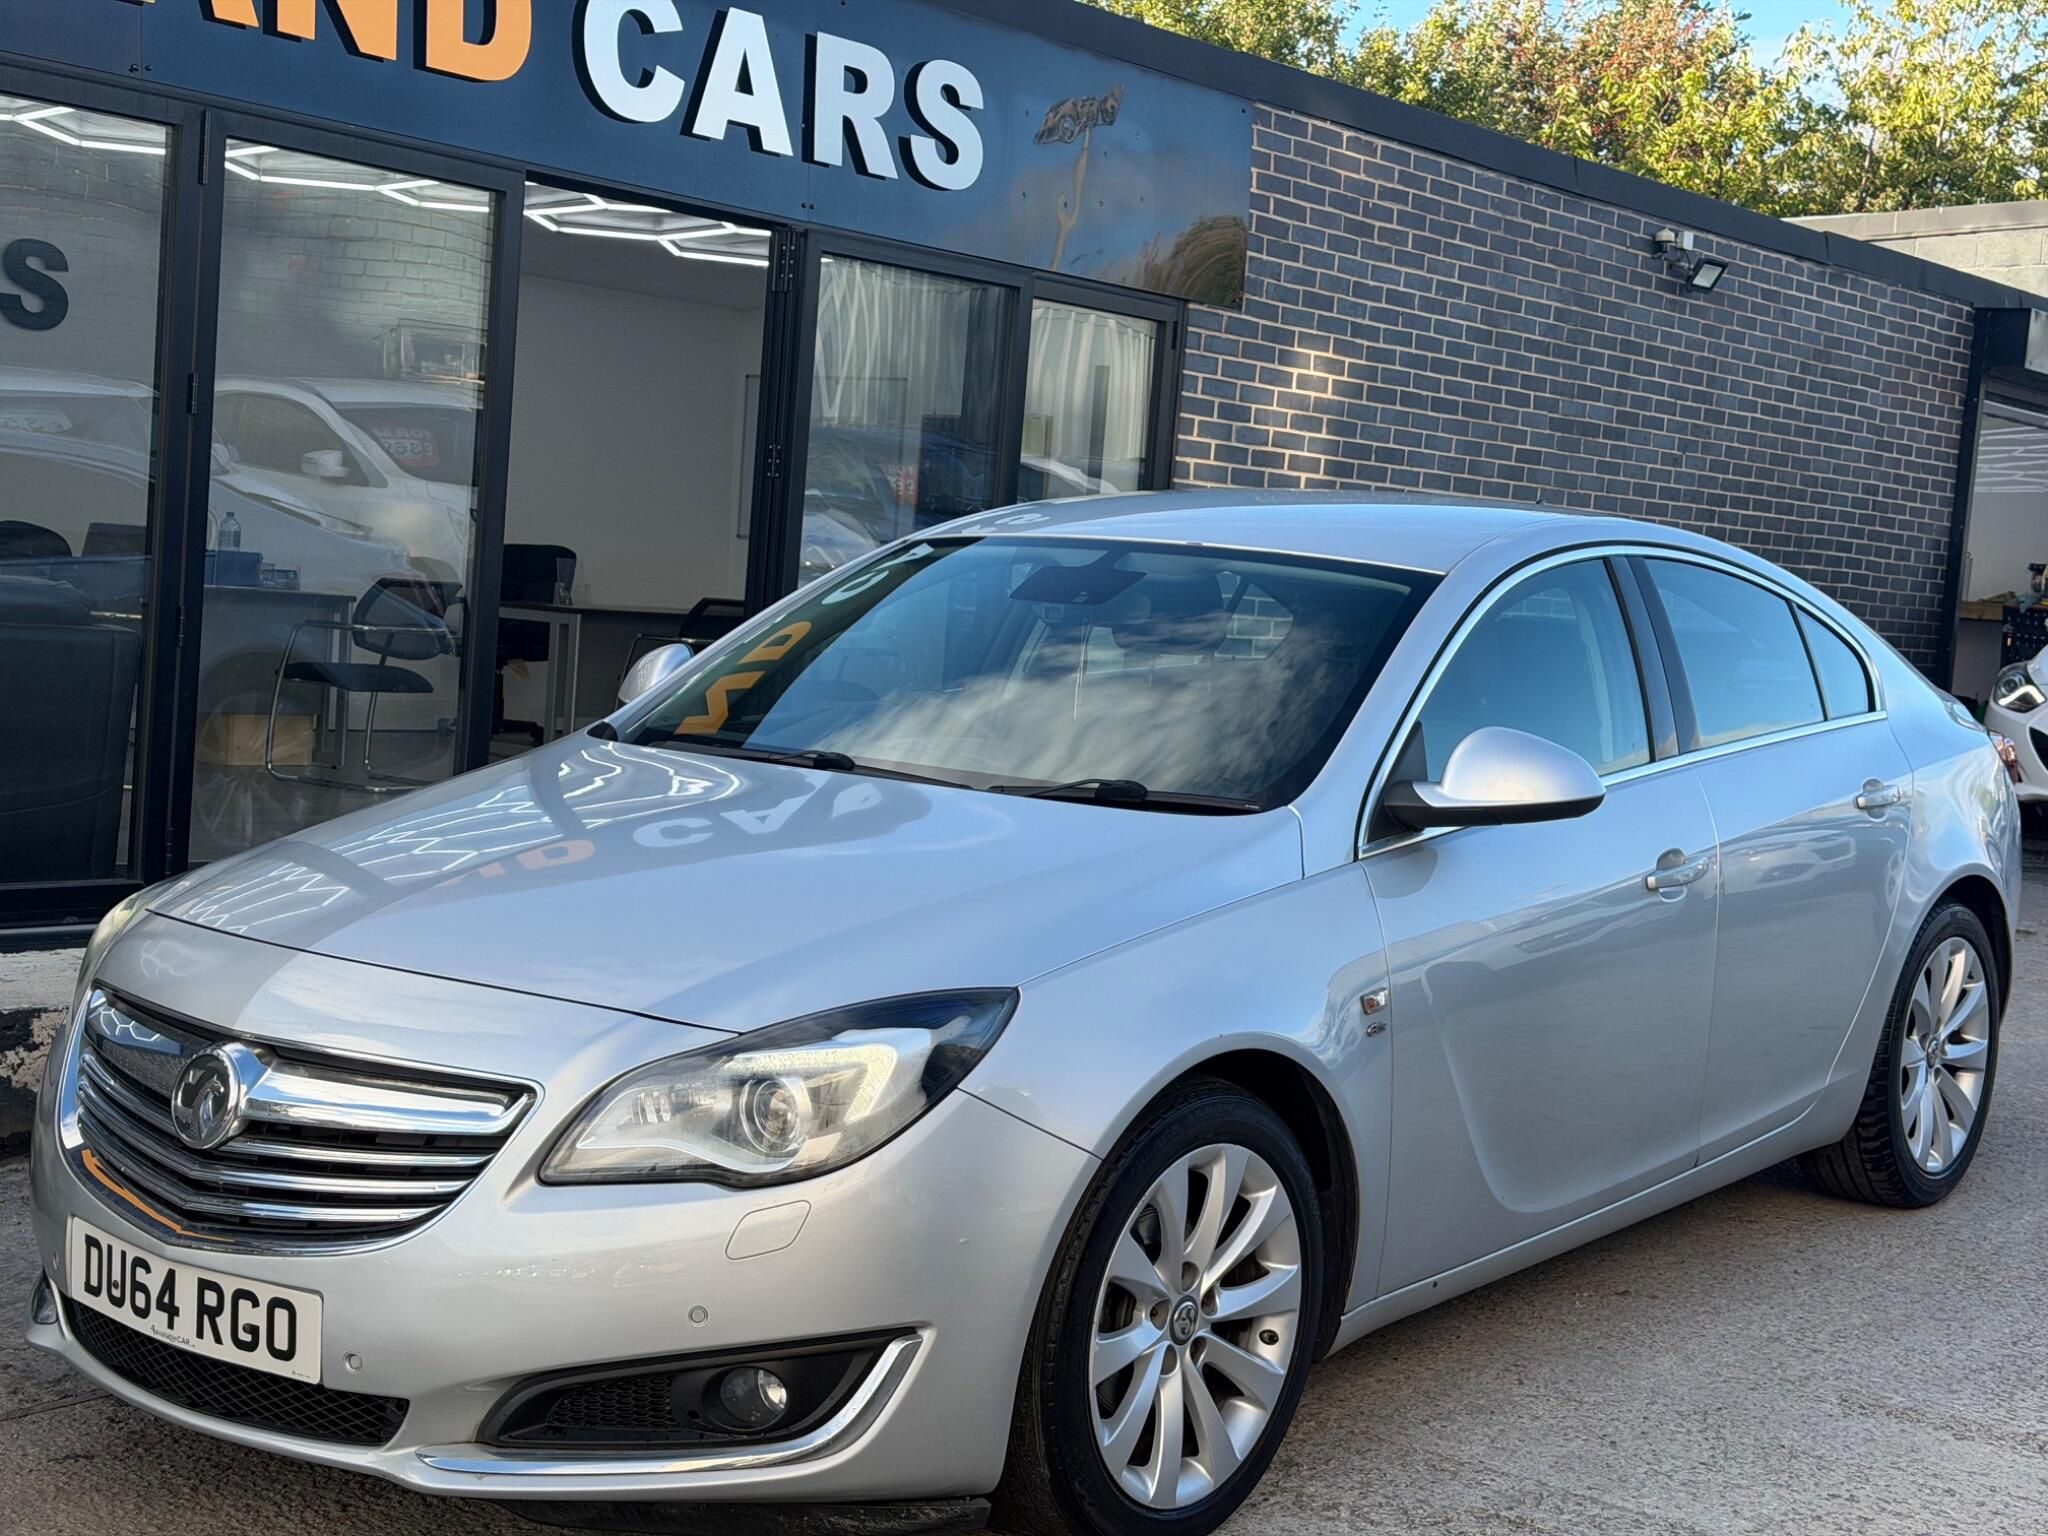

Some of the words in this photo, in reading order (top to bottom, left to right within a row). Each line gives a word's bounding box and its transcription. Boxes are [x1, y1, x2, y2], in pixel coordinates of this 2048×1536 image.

[580, 0, 984, 190] CARS
[0, 239, 69, 331] S
[84, 1233, 180, 1331] DU64
[196, 1276, 297, 1362] RGO
